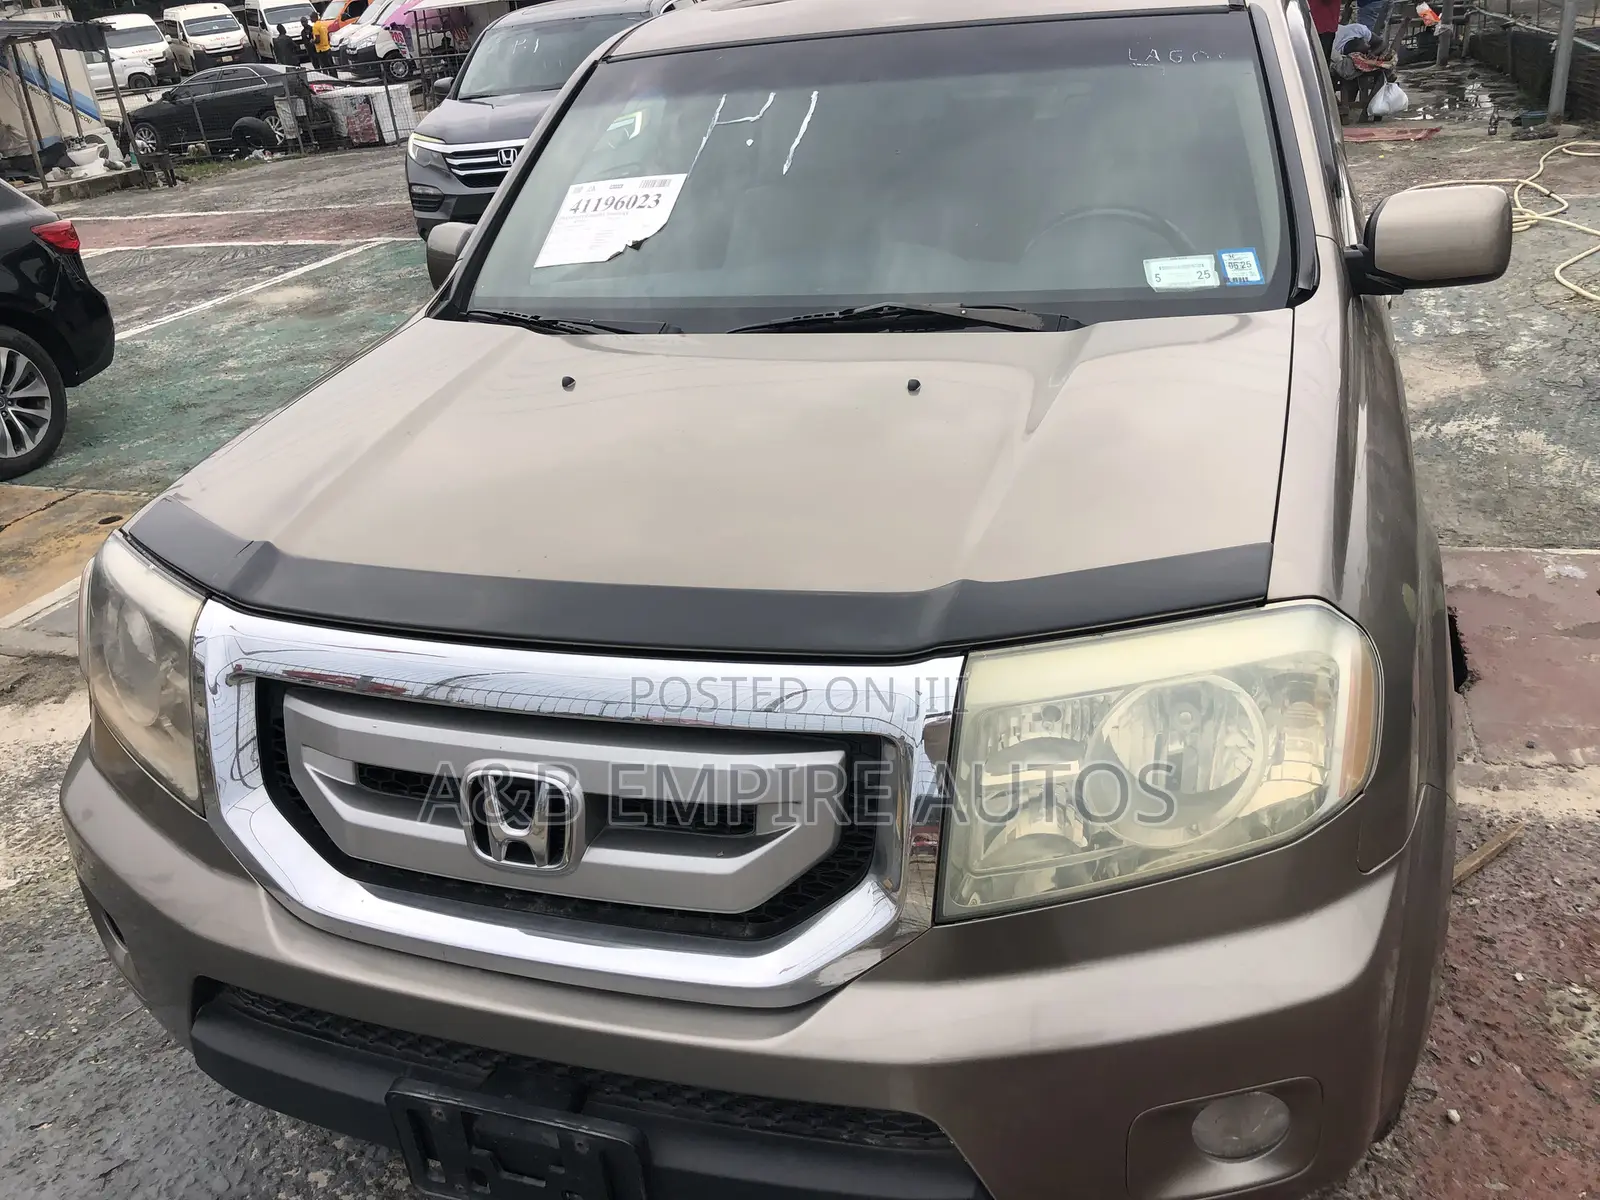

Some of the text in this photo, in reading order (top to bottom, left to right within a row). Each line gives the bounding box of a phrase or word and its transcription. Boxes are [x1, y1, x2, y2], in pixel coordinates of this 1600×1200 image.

[569, 193, 662, 214] 41196023
[1154, 269, 1211, 283] 5 25
